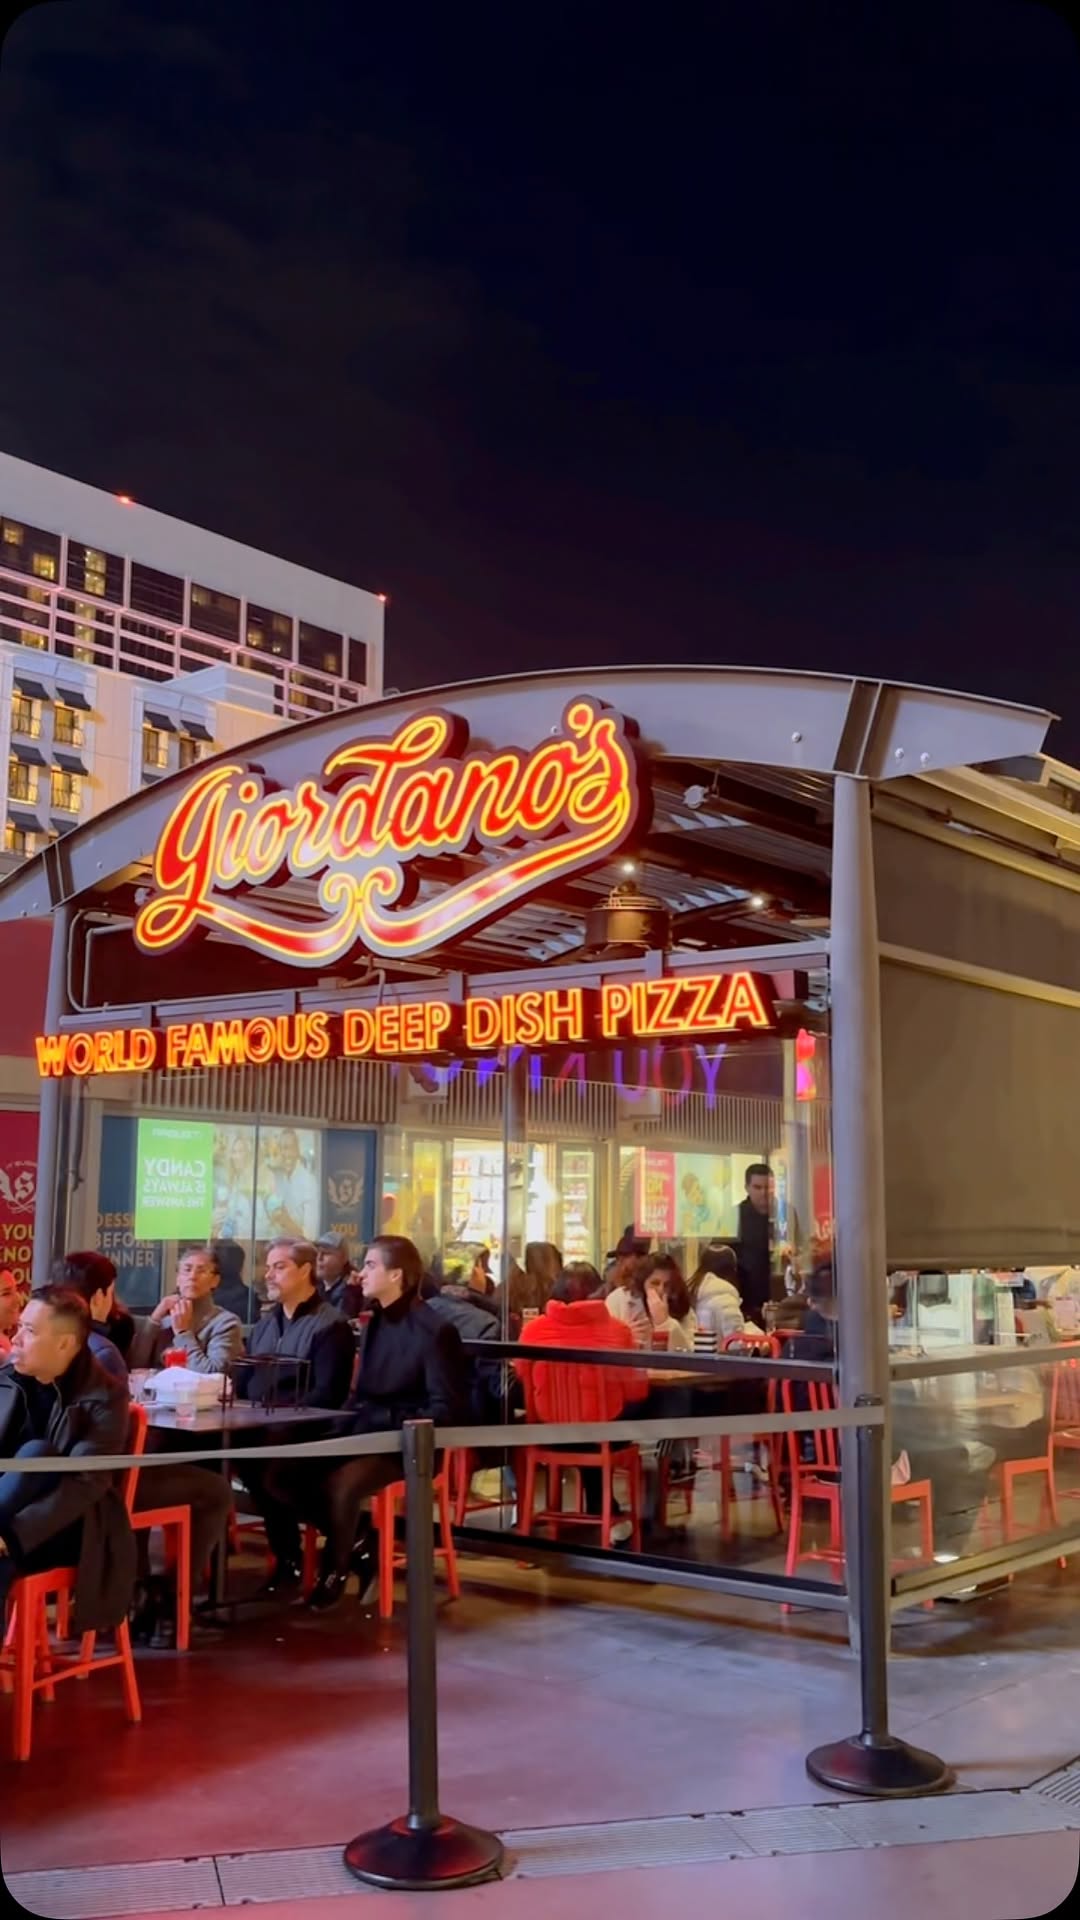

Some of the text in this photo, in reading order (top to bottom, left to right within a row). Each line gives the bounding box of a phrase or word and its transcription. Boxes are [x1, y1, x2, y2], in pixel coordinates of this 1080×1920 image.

[135, 701, 632, 957] Giordano's
[35, 971, 770, 1079] WORLD FAMOUS DEEP DISH PIZZA
